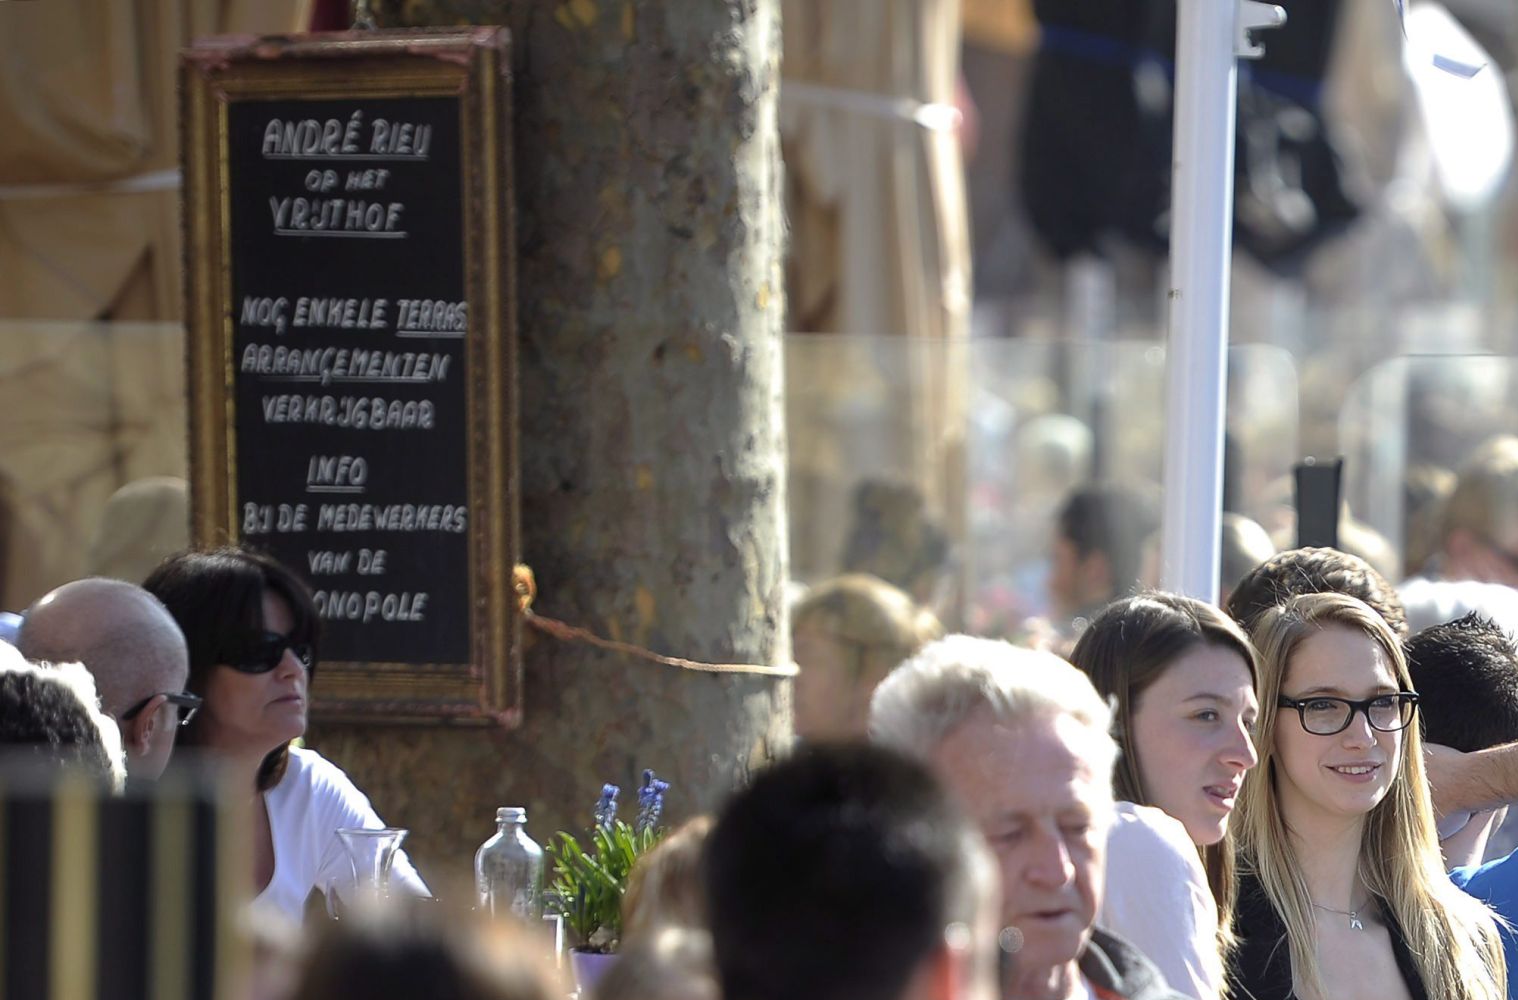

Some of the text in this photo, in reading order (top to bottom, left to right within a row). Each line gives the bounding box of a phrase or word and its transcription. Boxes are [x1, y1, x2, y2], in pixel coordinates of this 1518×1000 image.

[262, 110, 433, 156] ANDRÉ RIEU
[305, 168, 391, 192] OP HET
[240, 296, 468, 335] NOG ENKELE TERRAS
[241, 342, 451, 385] ARRANGEMENTEN
[307, 456, 368, 485] INFO
[276, 503, 309, 532] DE
[317, 503, 468, 533] MEDEWERKERS
[308, 548, 387, 575] VAN DE
[312, 590, 429, 623] ONOPOLE
